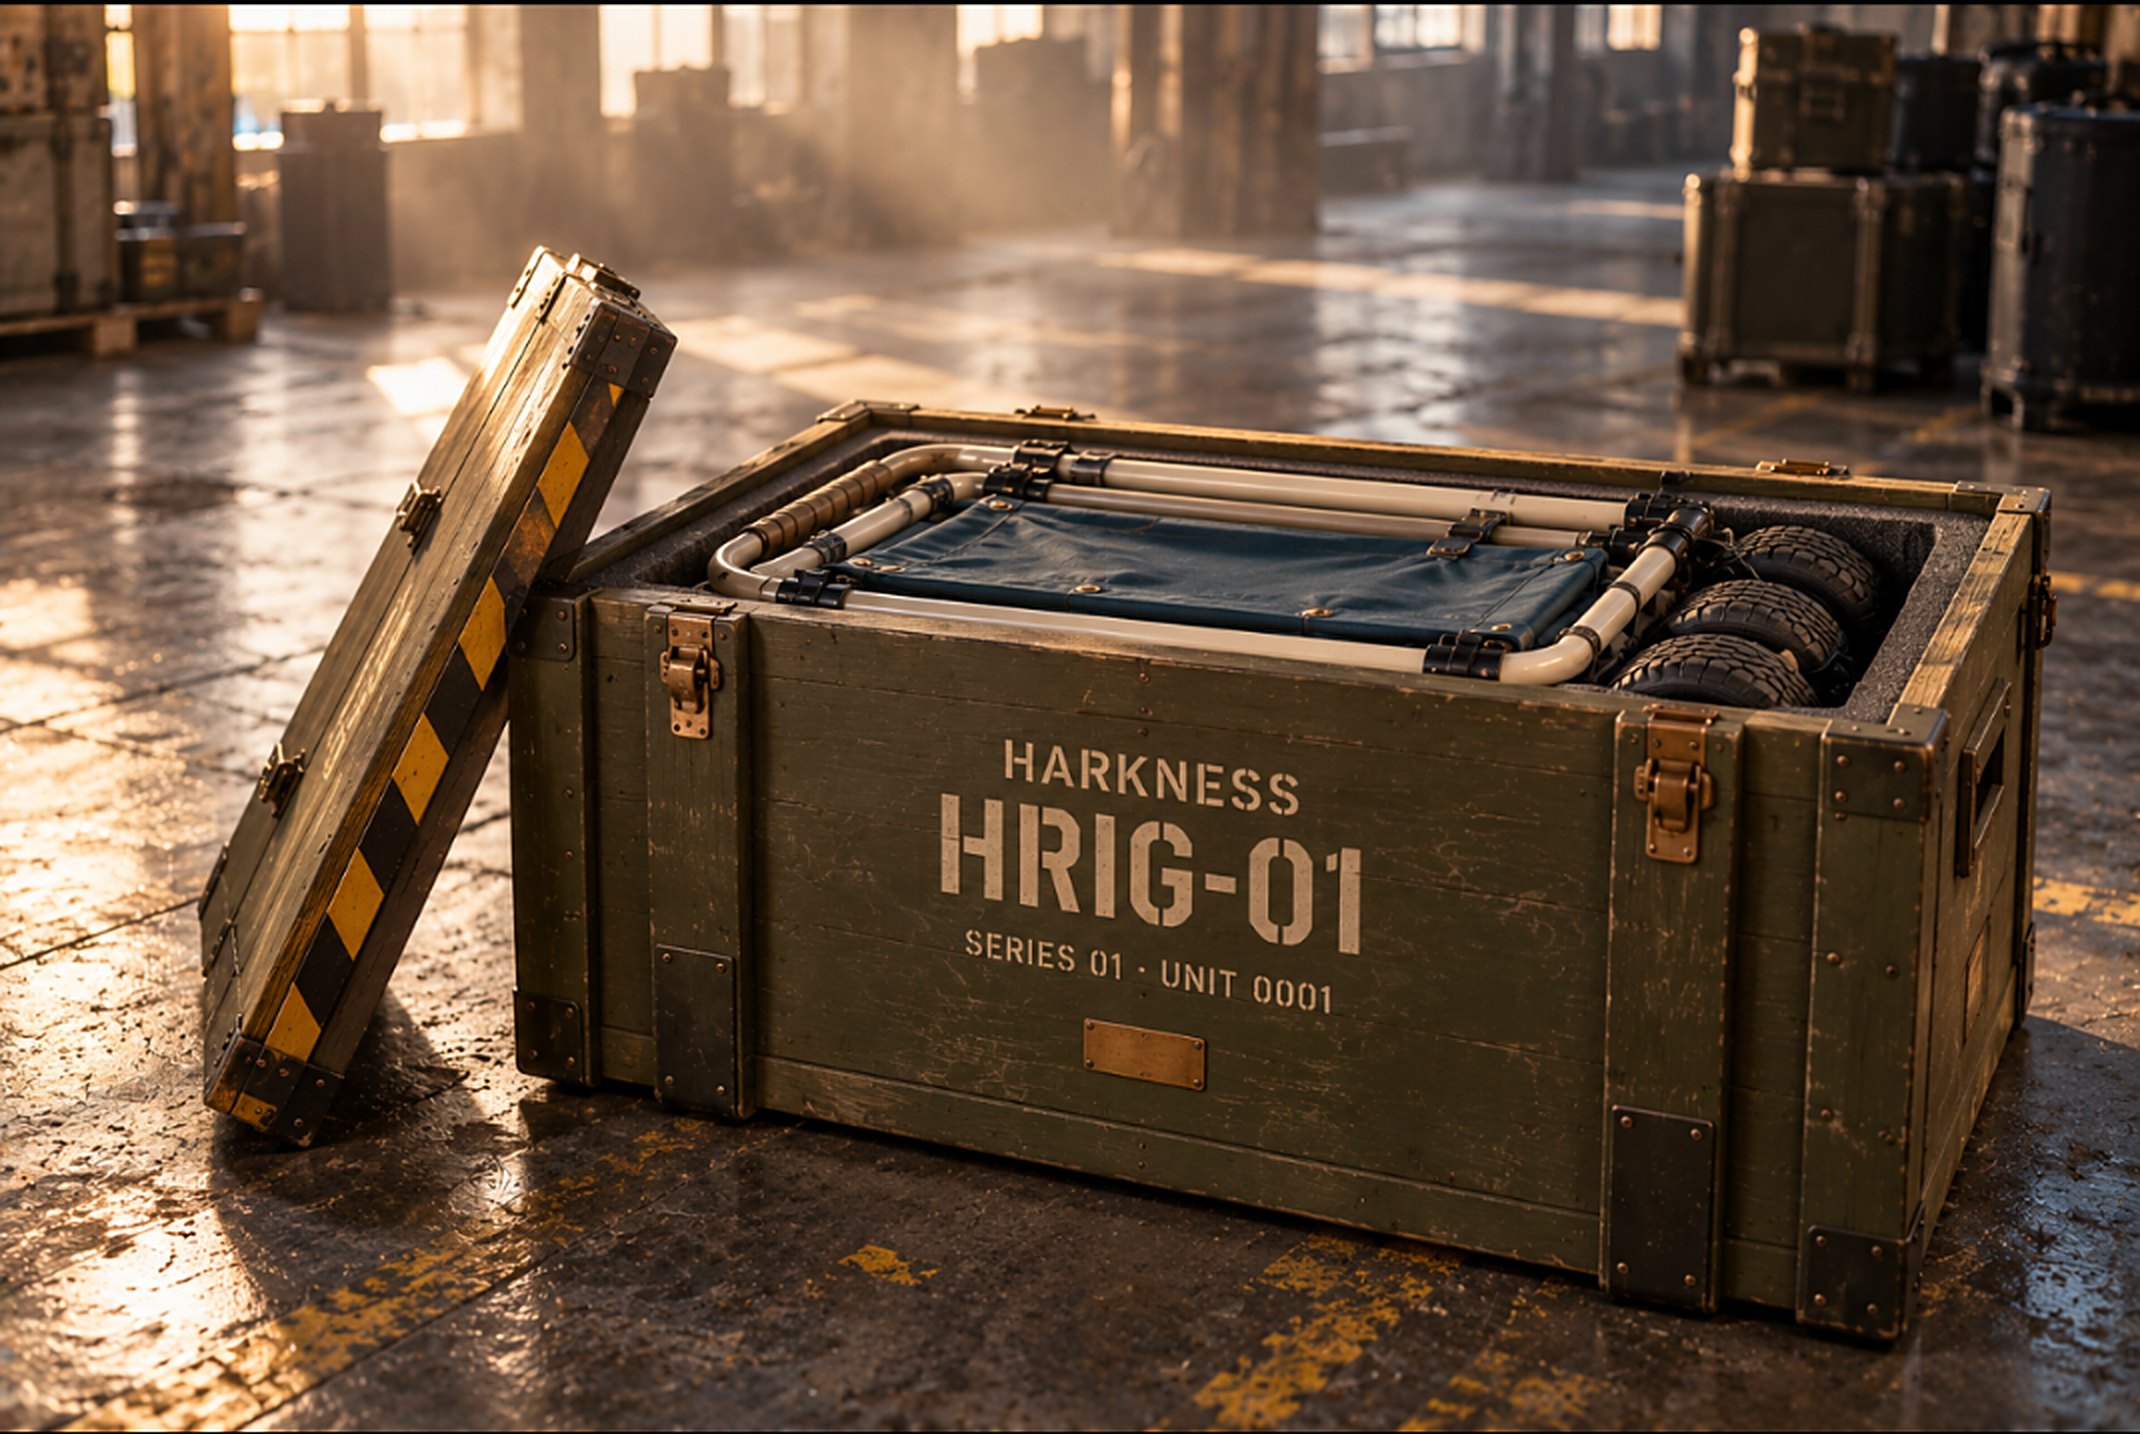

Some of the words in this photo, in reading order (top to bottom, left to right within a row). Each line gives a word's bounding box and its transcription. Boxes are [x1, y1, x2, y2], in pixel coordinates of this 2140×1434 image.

[1004, 738, 1300, 816] HARKNESS
[940, 792, 1362, 955] HRIG-01
[964, 929, 1076, 972] SERIES
[1089, 949, 1121, 980] 01
[1161, 959, 1237, 999] UNIT
[1253, 975, 1332, 1014] 0001
